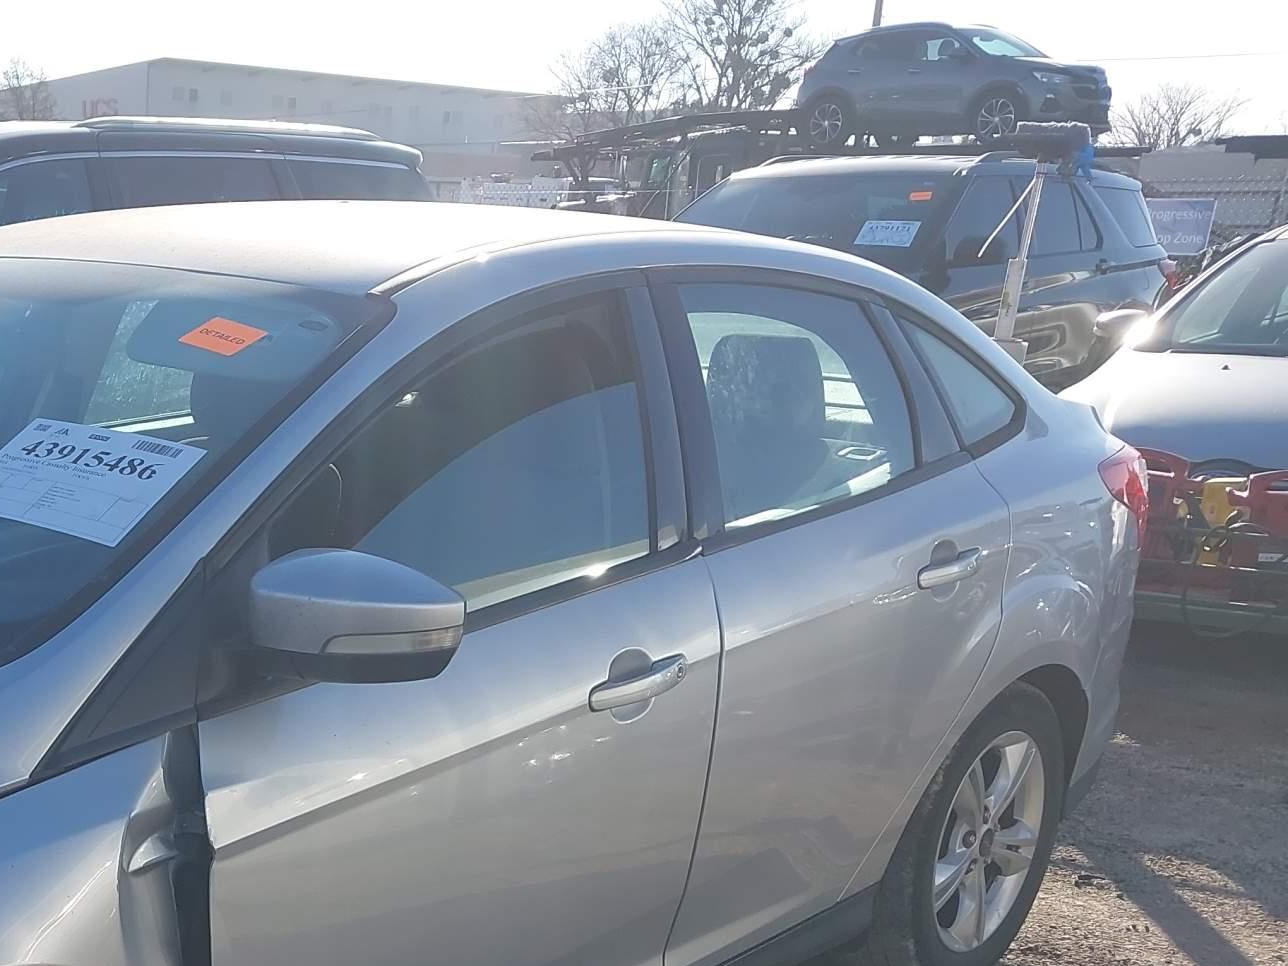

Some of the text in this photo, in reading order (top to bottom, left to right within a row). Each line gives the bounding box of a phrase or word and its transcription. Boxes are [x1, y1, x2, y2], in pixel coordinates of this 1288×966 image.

[1150, 209, 1212, 222] rogressive
[199, 327, 246, 345] DETAILED
[21, 439, 165, 480] 43915486
